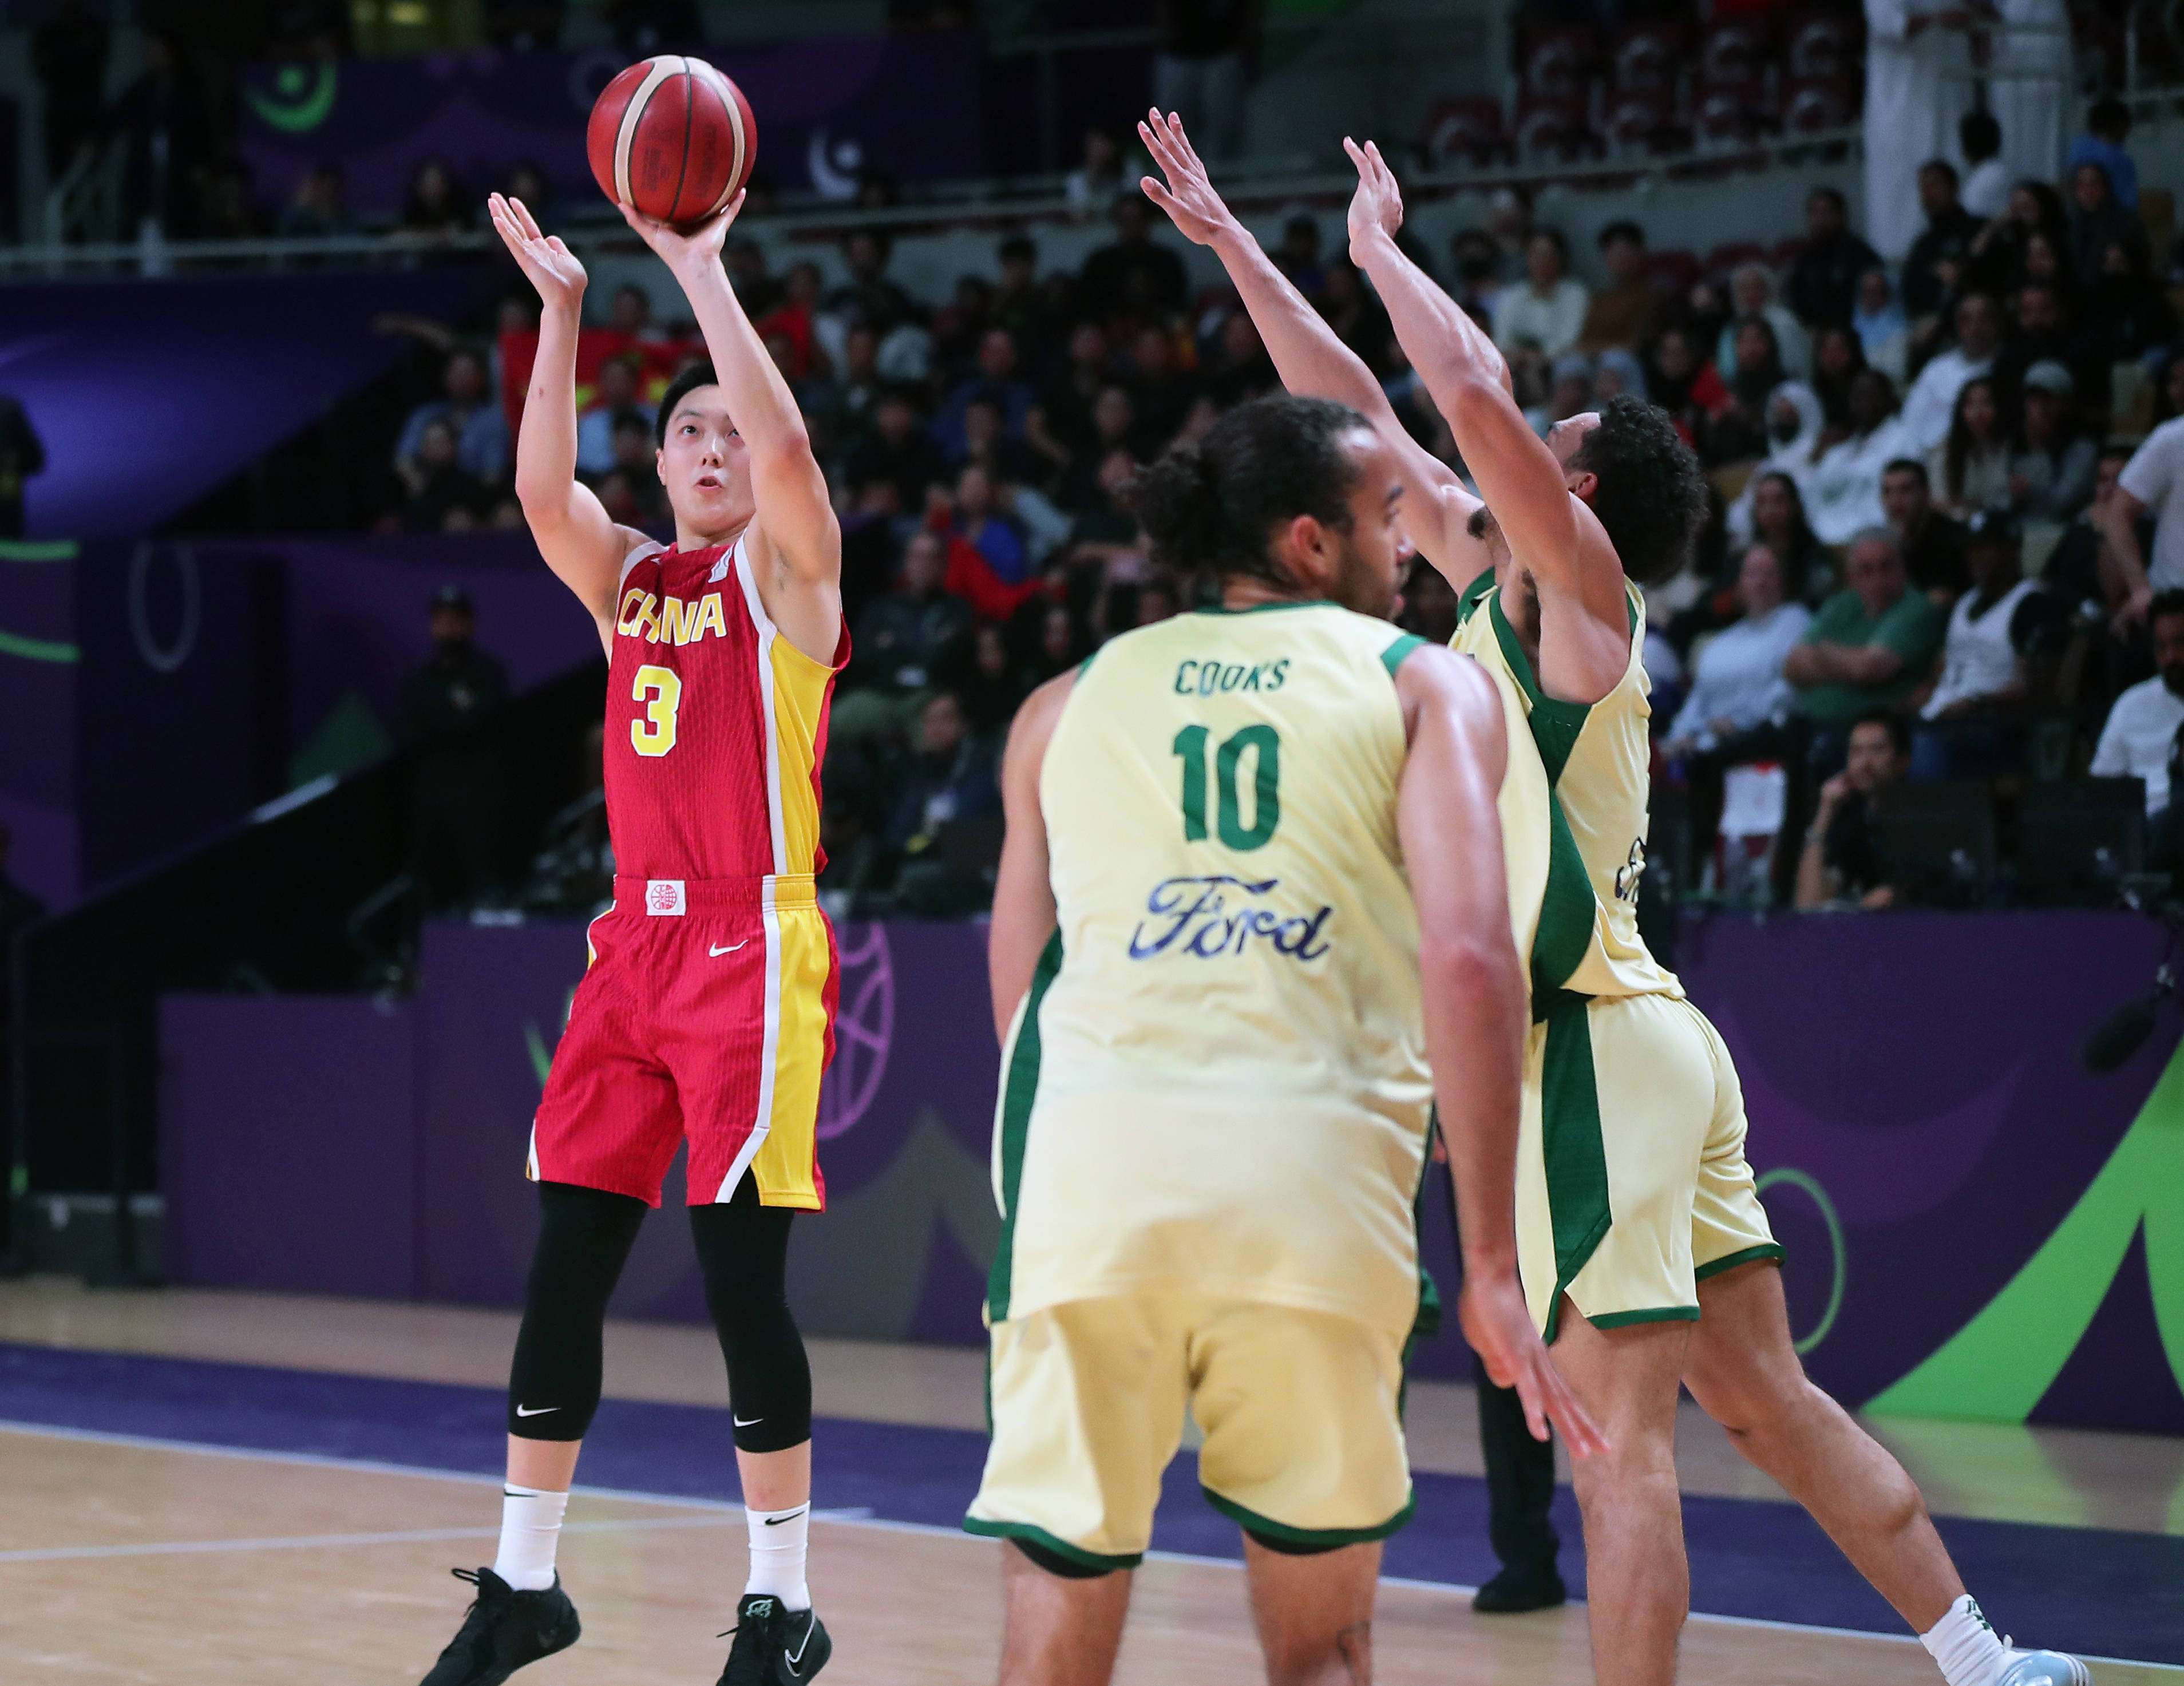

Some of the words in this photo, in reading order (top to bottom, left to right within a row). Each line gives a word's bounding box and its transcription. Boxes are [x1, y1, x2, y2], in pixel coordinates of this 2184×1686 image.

[617, 587, 727, 646] CHNA
[631, 664, 682, 758] 3
[1174, 659, 1292, 697] COOKS
[1173, 724, 1281, 852] 10
[1128, 874, 1336, 962] Ford
